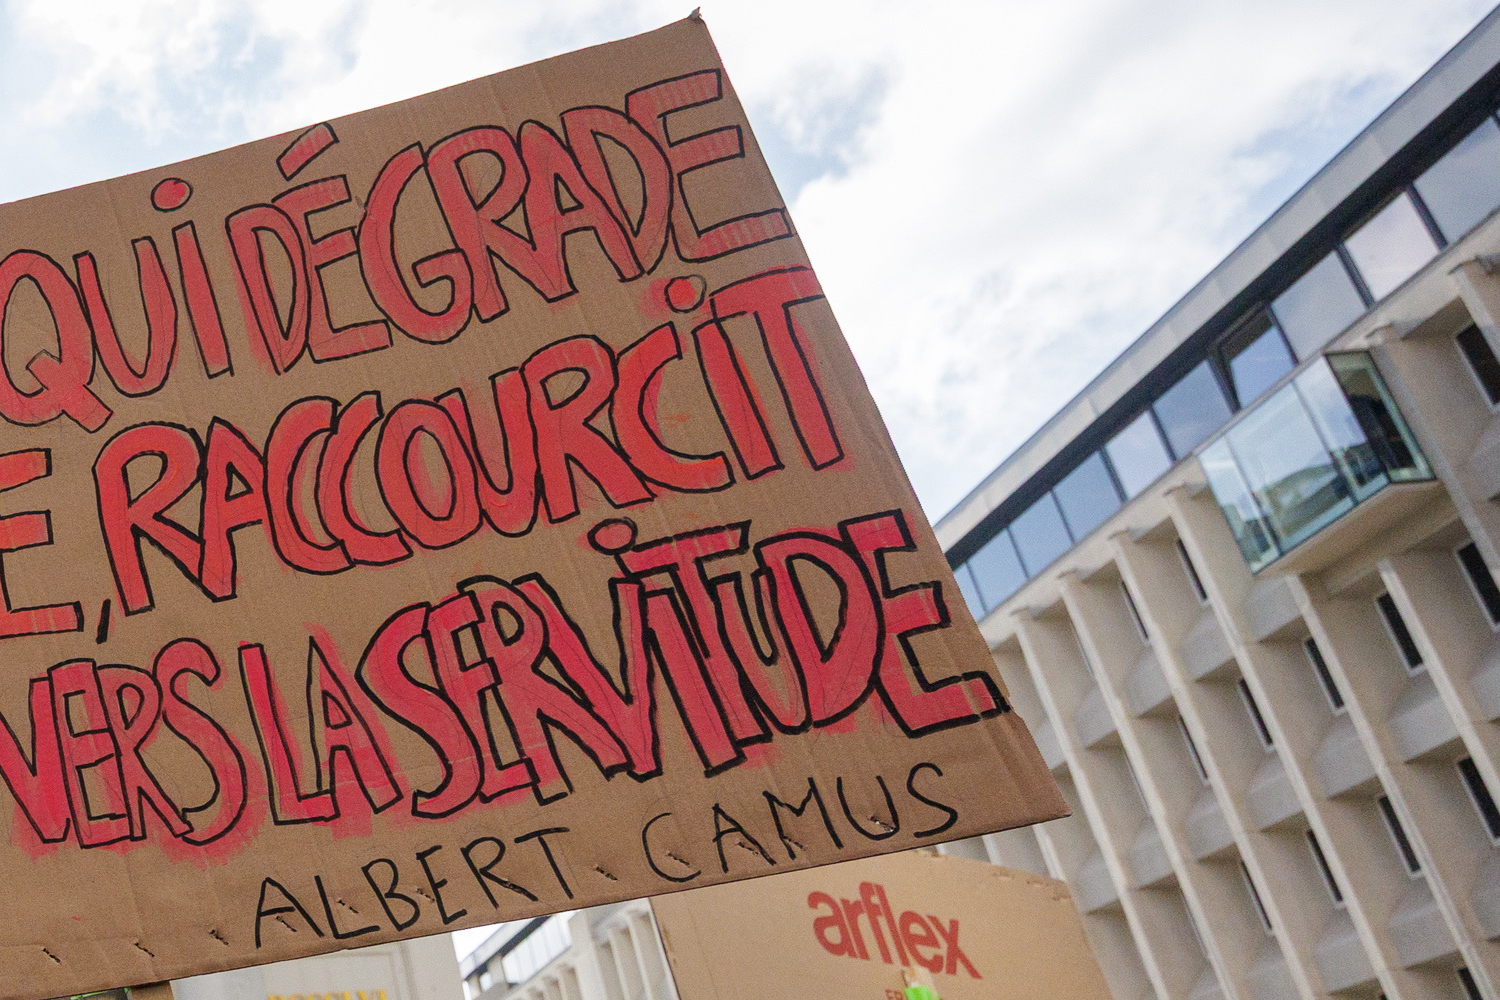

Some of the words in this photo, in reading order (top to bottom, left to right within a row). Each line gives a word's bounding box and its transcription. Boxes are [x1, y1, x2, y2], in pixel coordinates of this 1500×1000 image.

[227, 68, 794, 376] DÉGRADE
[239, 635, 405, 826] LA
[254, 826, 576, 948] ALBERT
[641, 763, 960, 884] CAMUS
[807, 881, 984, 980] arflex
